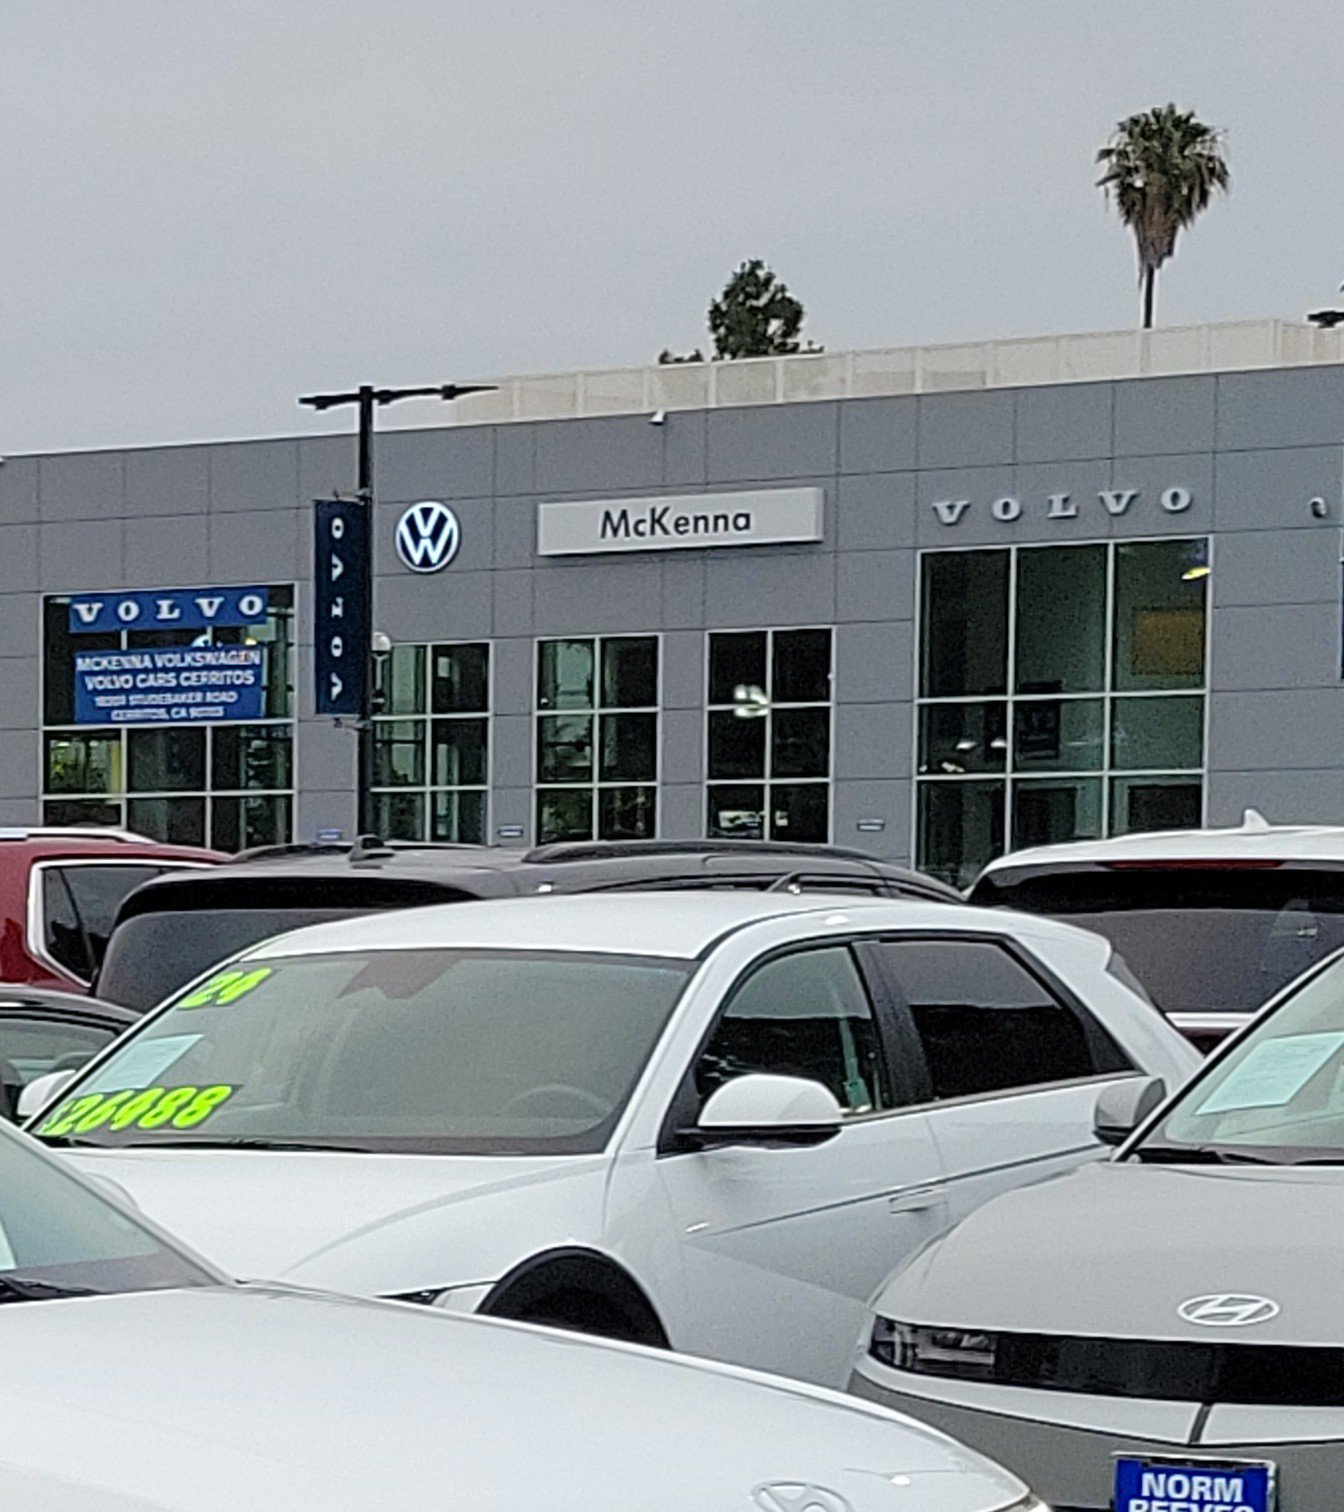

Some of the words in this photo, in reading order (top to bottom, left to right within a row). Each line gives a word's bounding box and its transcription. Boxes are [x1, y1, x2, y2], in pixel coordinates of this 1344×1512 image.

[932, 487, 1192, 526] VOLVO
[600, 506, 752, 540] McKenna
[73, 595, 263, 624] VOLVO
[330, 517, 344, 701] VOLVO
[76, 653, 153, 672] MCKENNA
[154, 650, 261, 668] VOLKSWAGEN
[84, 674, 134, 691] VOLVO
[136, 672, 177, 687] CARS
[179, 669, 255, 687] CERRITOS
[1141, 1472, 1243, 1503] NORM
